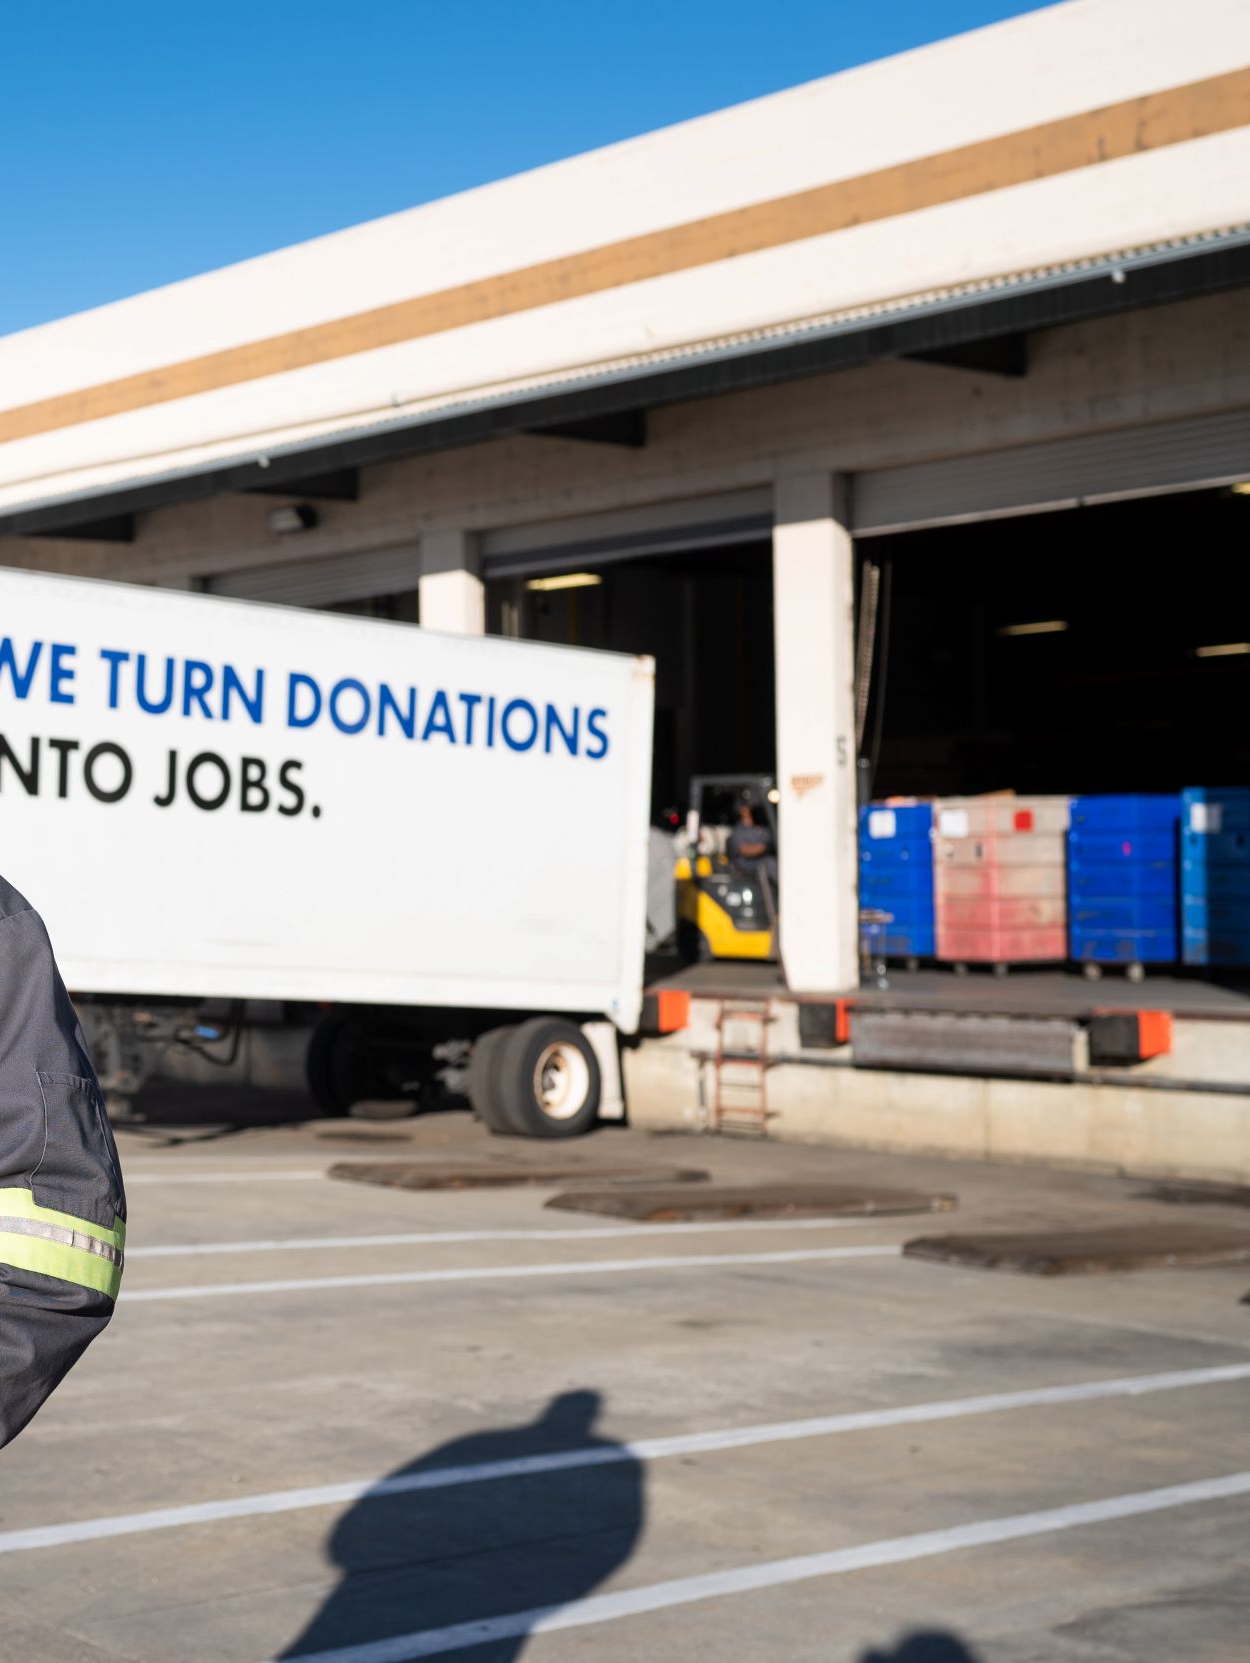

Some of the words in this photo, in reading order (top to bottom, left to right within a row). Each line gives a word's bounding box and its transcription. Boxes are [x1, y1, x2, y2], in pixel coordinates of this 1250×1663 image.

[100, 649, 265, 725] TURN
[287, 672, 609, 760] DONATIONS
[154, 750, 321, 818] JOBS.
